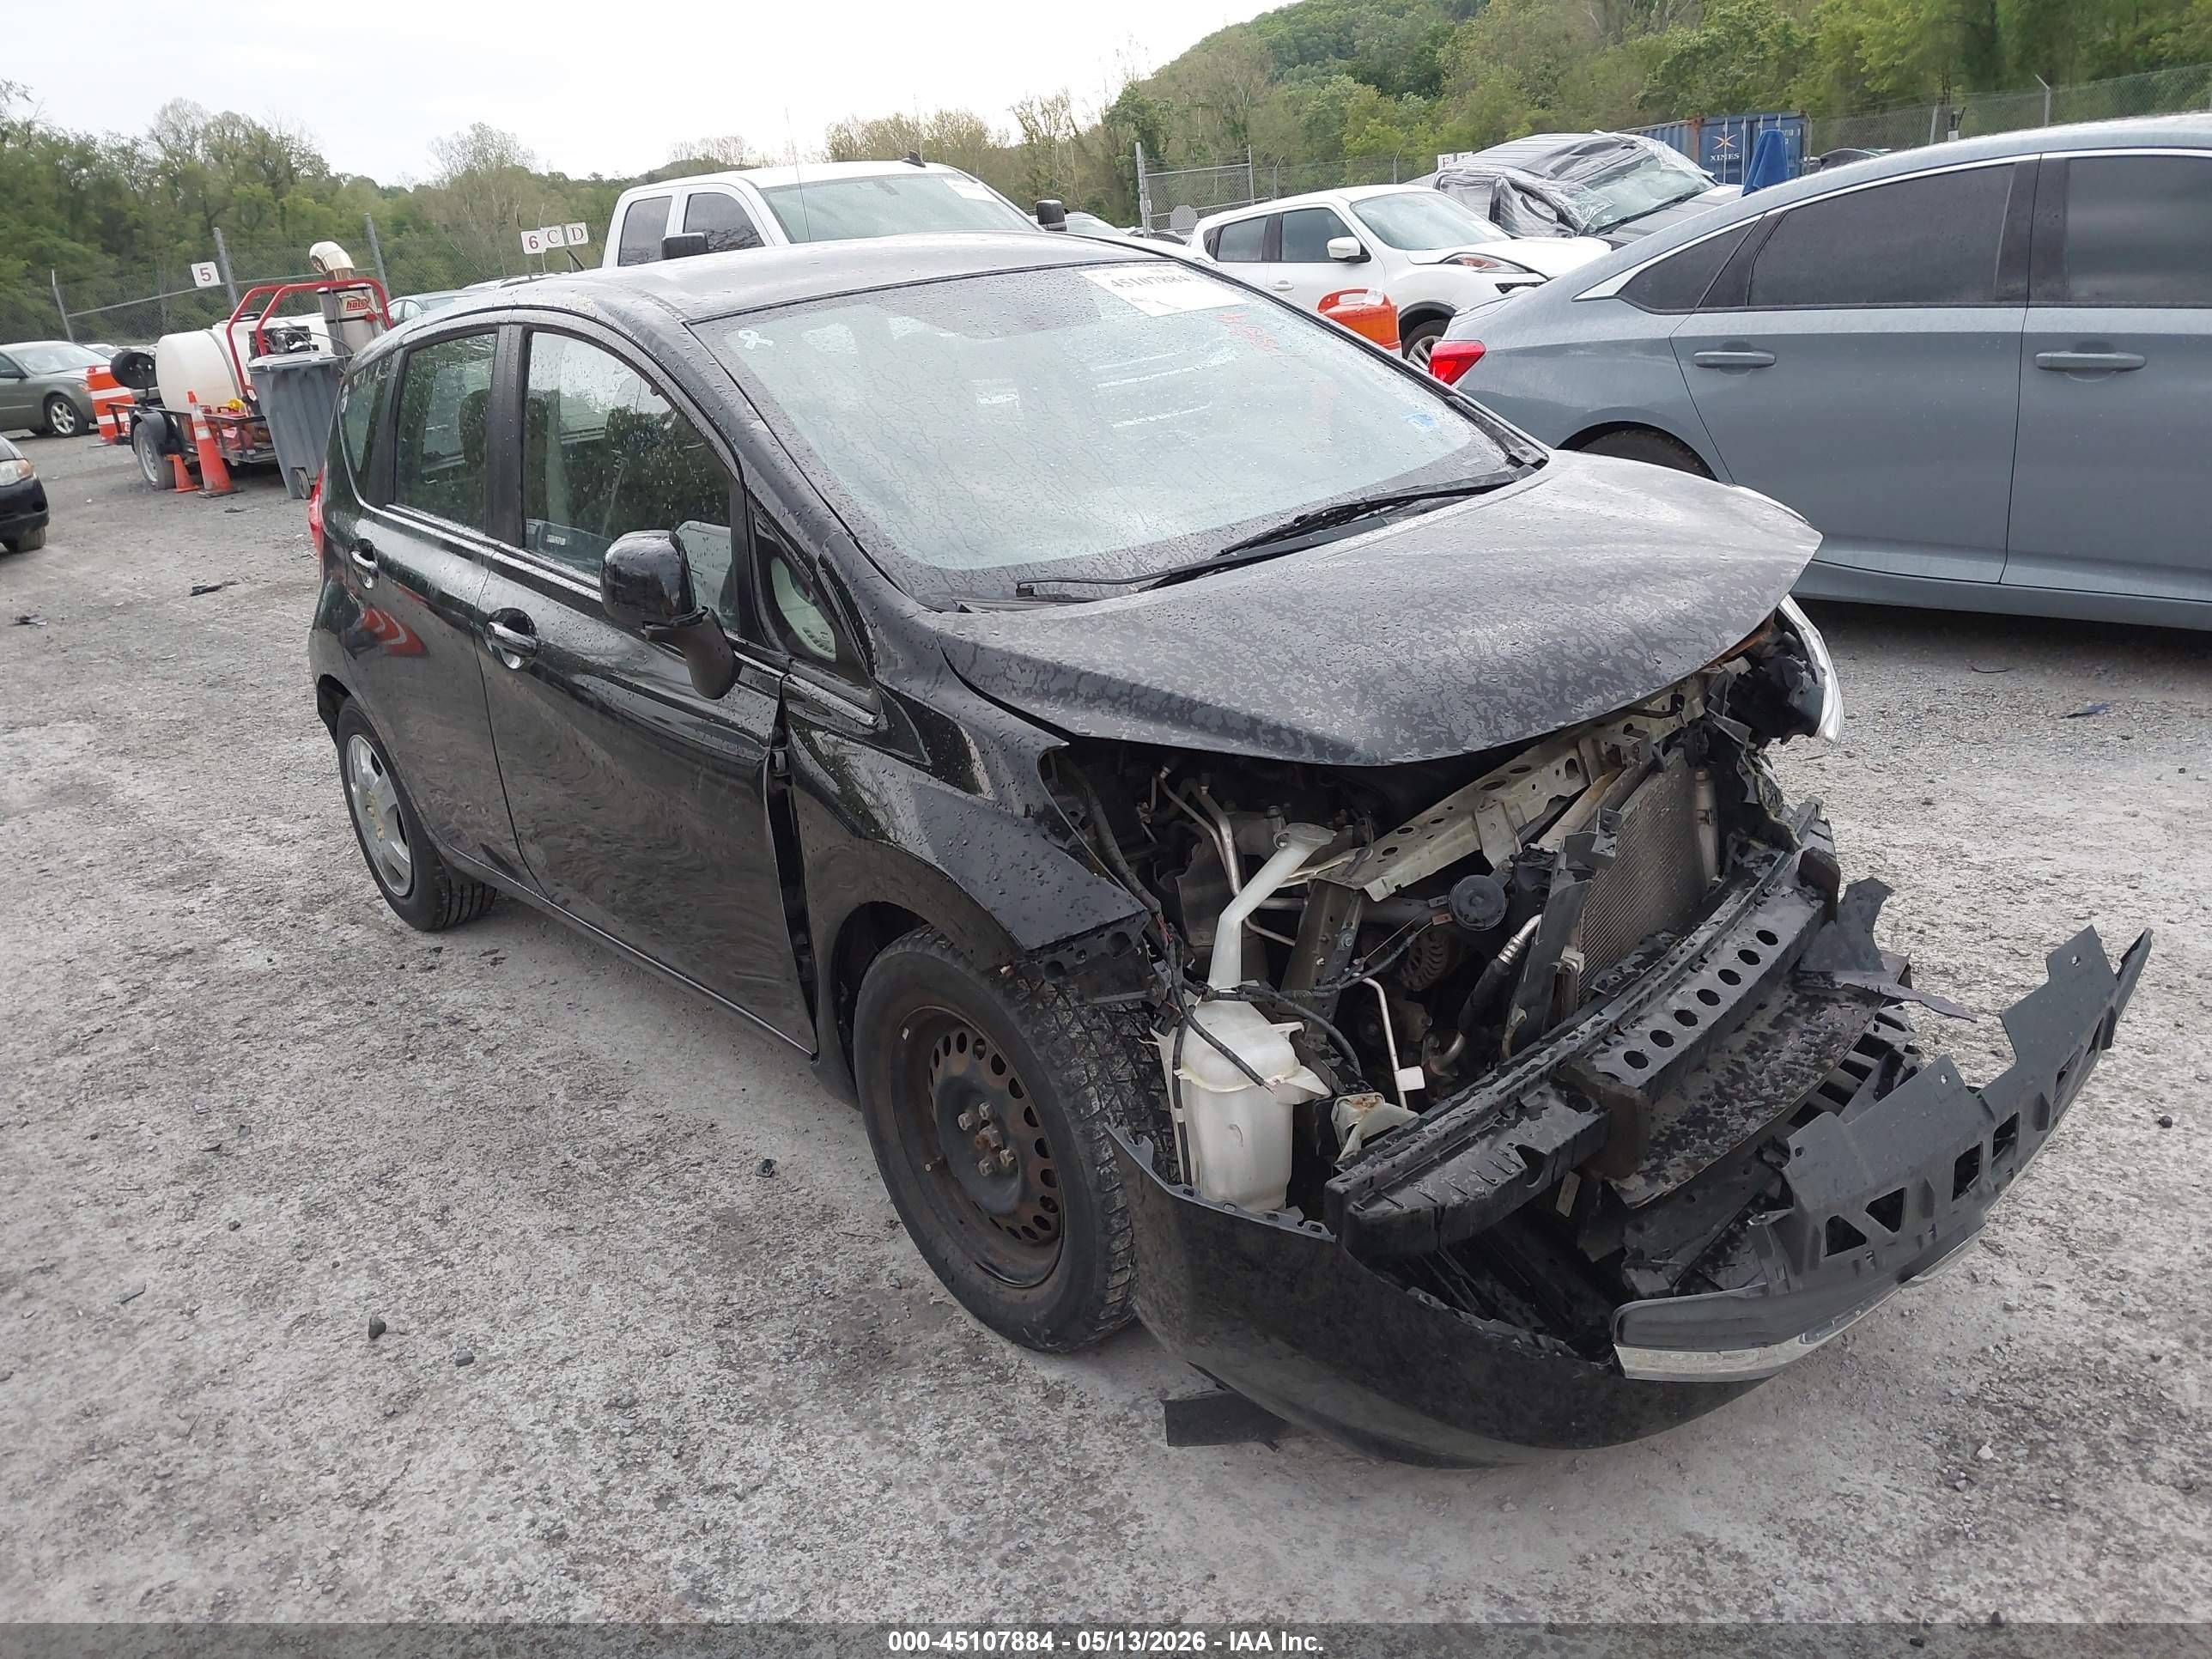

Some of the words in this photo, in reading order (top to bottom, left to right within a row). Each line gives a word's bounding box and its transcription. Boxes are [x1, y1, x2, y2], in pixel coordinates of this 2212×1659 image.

[528, 235, 539, 249] 6
[547, 229, 560, 244] C
[571, 227, 584, 241] D
[199, 267, 212, 282] 5
